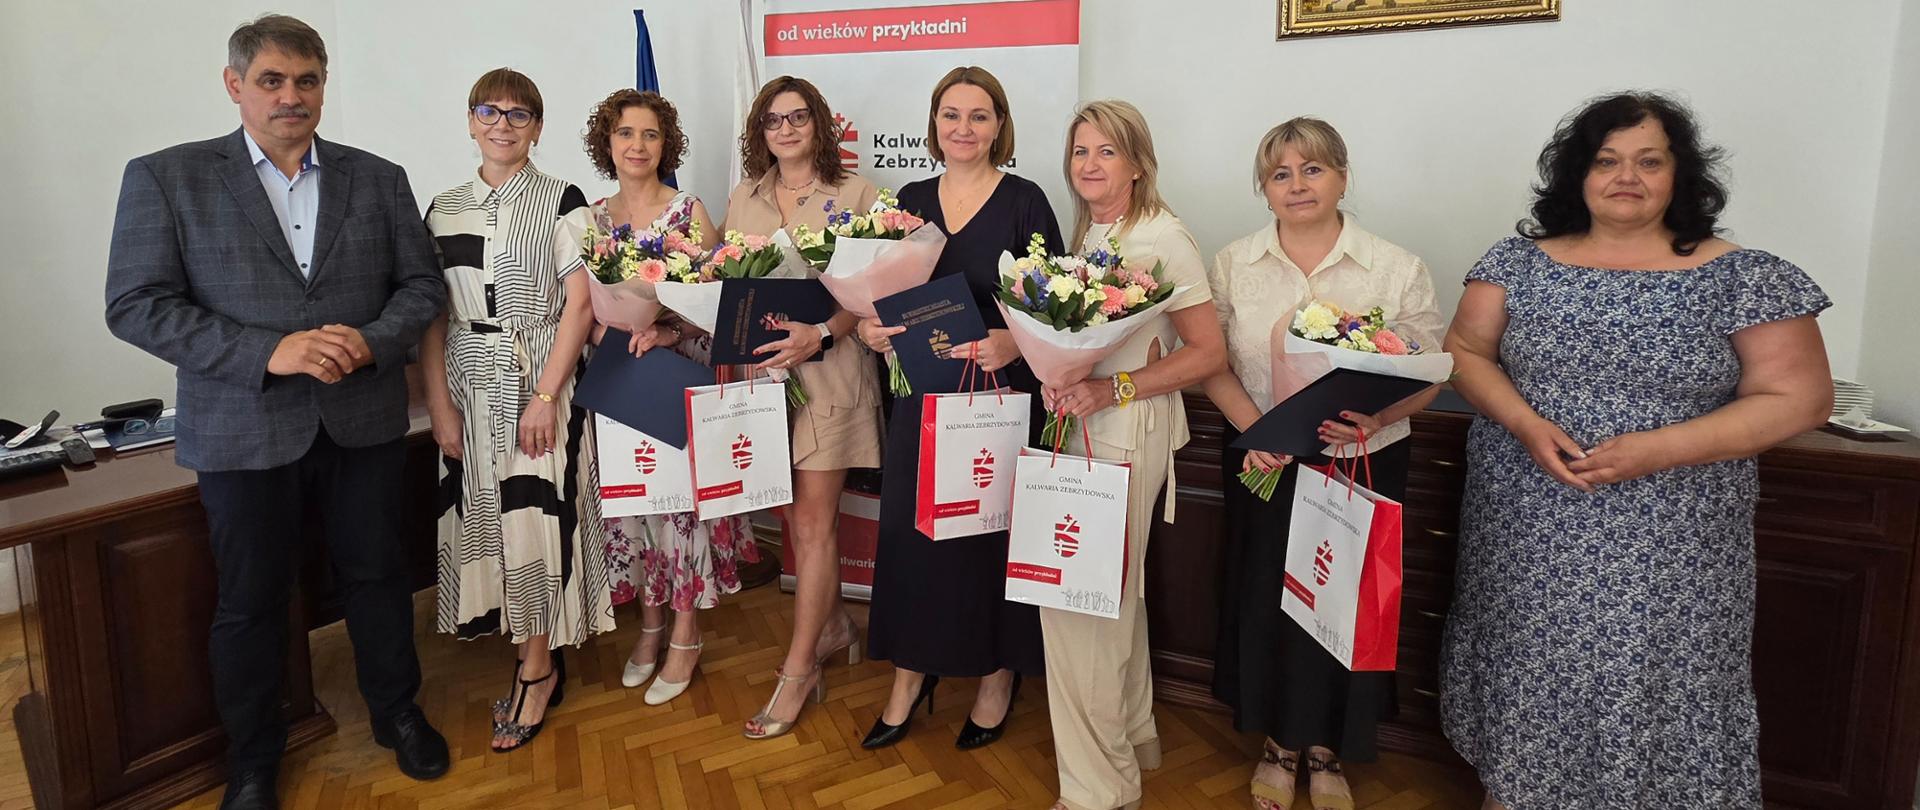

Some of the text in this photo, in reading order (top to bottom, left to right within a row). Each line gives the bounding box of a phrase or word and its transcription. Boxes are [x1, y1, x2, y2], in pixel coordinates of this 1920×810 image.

[777, 17, 967, 41] od wieków przykładni
[873, 133, 928, 149] Kalw
[1058, 476, 1082, 485] GMINA
[1026, 483, 1115, 500] KALWARIA ZEBRZYDOWSKA
